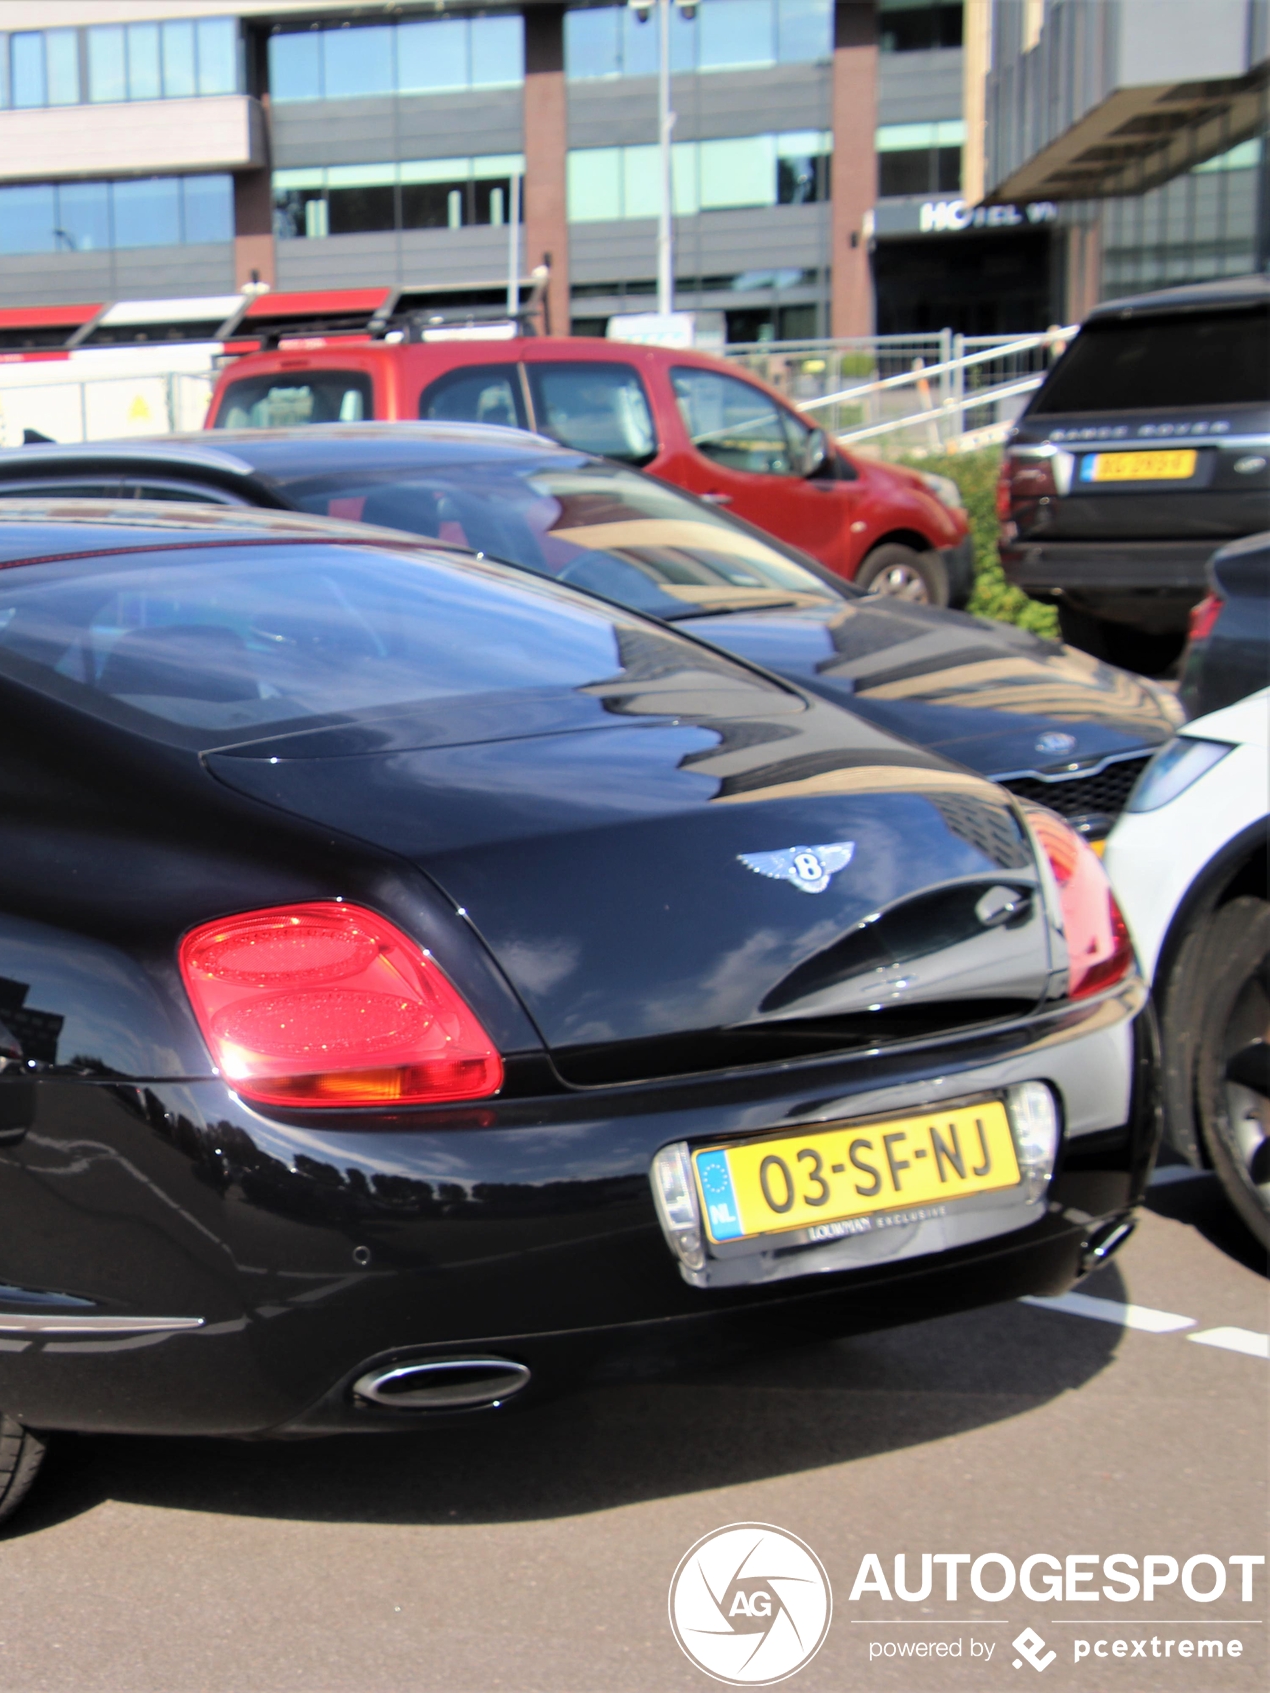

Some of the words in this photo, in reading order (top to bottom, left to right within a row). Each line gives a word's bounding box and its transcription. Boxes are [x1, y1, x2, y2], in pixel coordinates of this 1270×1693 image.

[759, 1118, 993, 1214] 03-SF-NJ
[709, 1202, 736, 1226] NL
[807, 1217, 872, 1242] LOUWMAN
[876, 1206, 946, 1229] EXCLUSIVE
